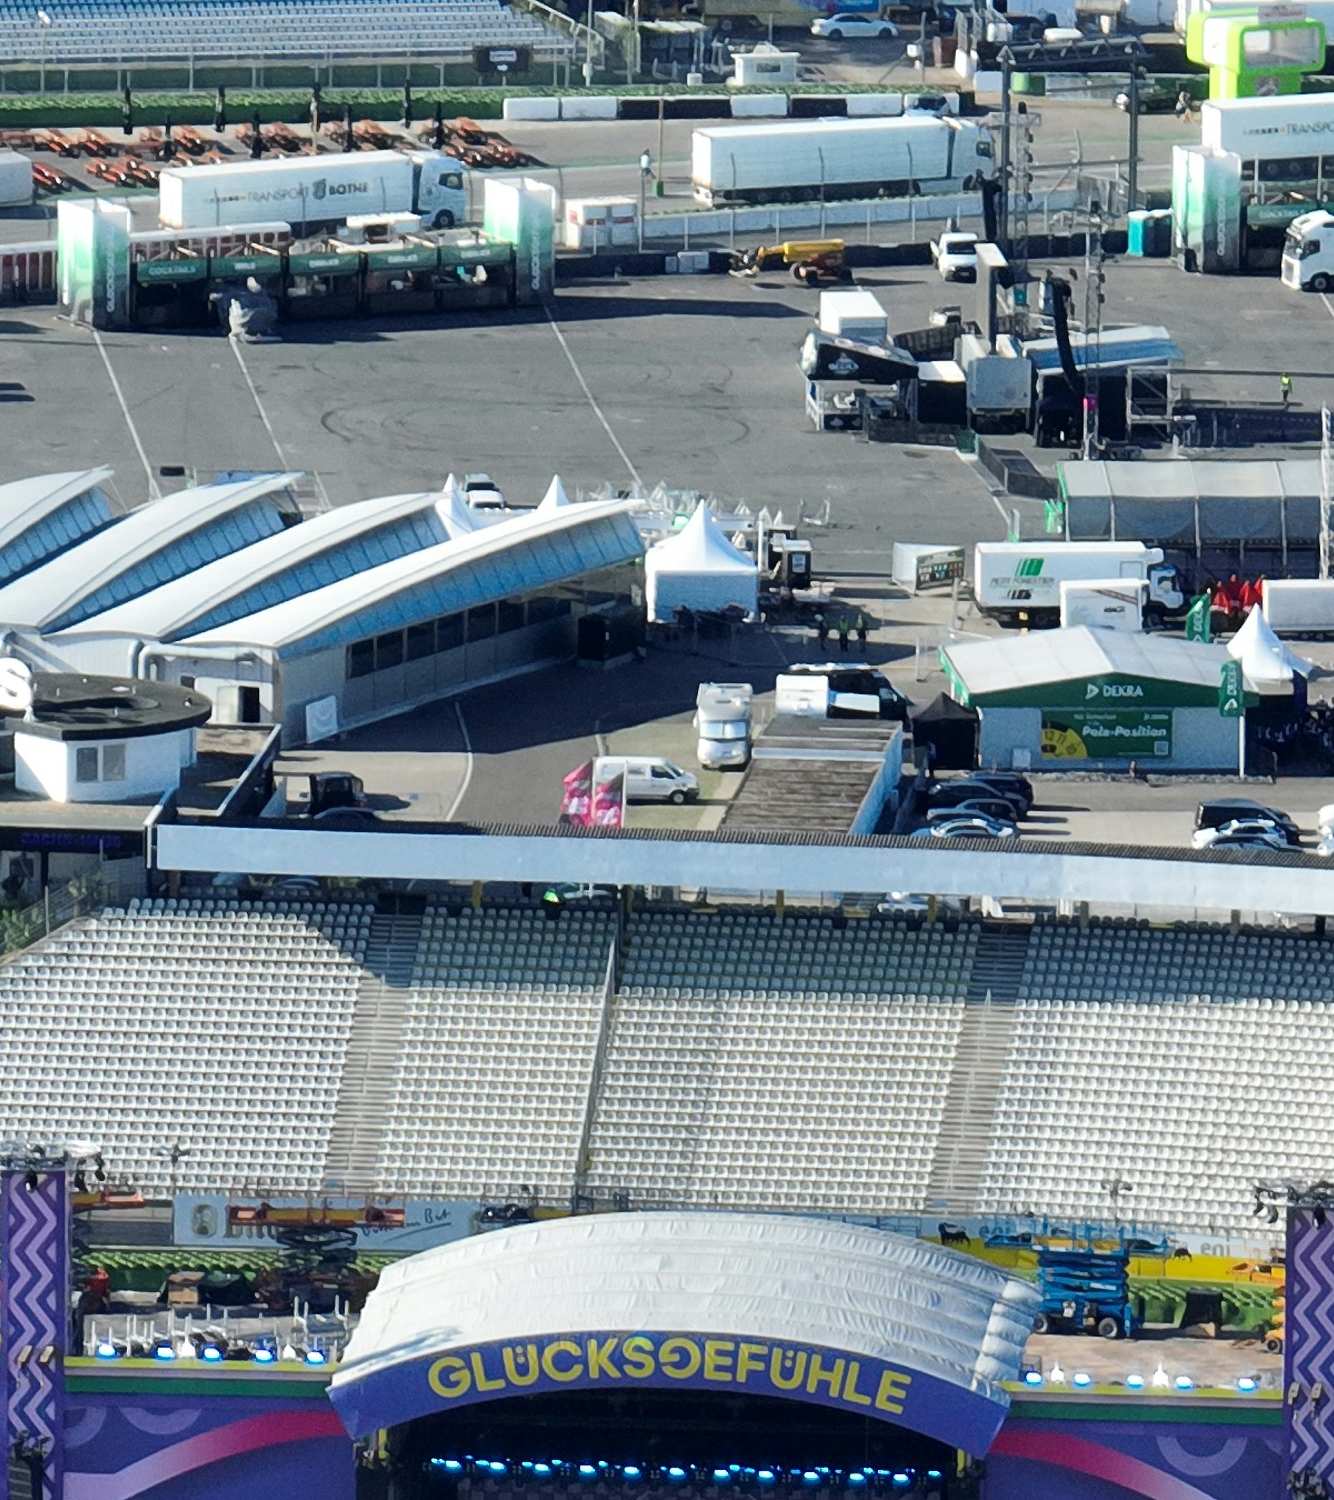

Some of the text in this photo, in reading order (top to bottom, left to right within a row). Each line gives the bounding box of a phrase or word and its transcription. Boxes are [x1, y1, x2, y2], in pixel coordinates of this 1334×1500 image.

[247, 187, 308, 202] TRANSPORT
[1102, 684, 1144, 698] DEKRA
[1081, 725, 1167, 737] Pole-Position
